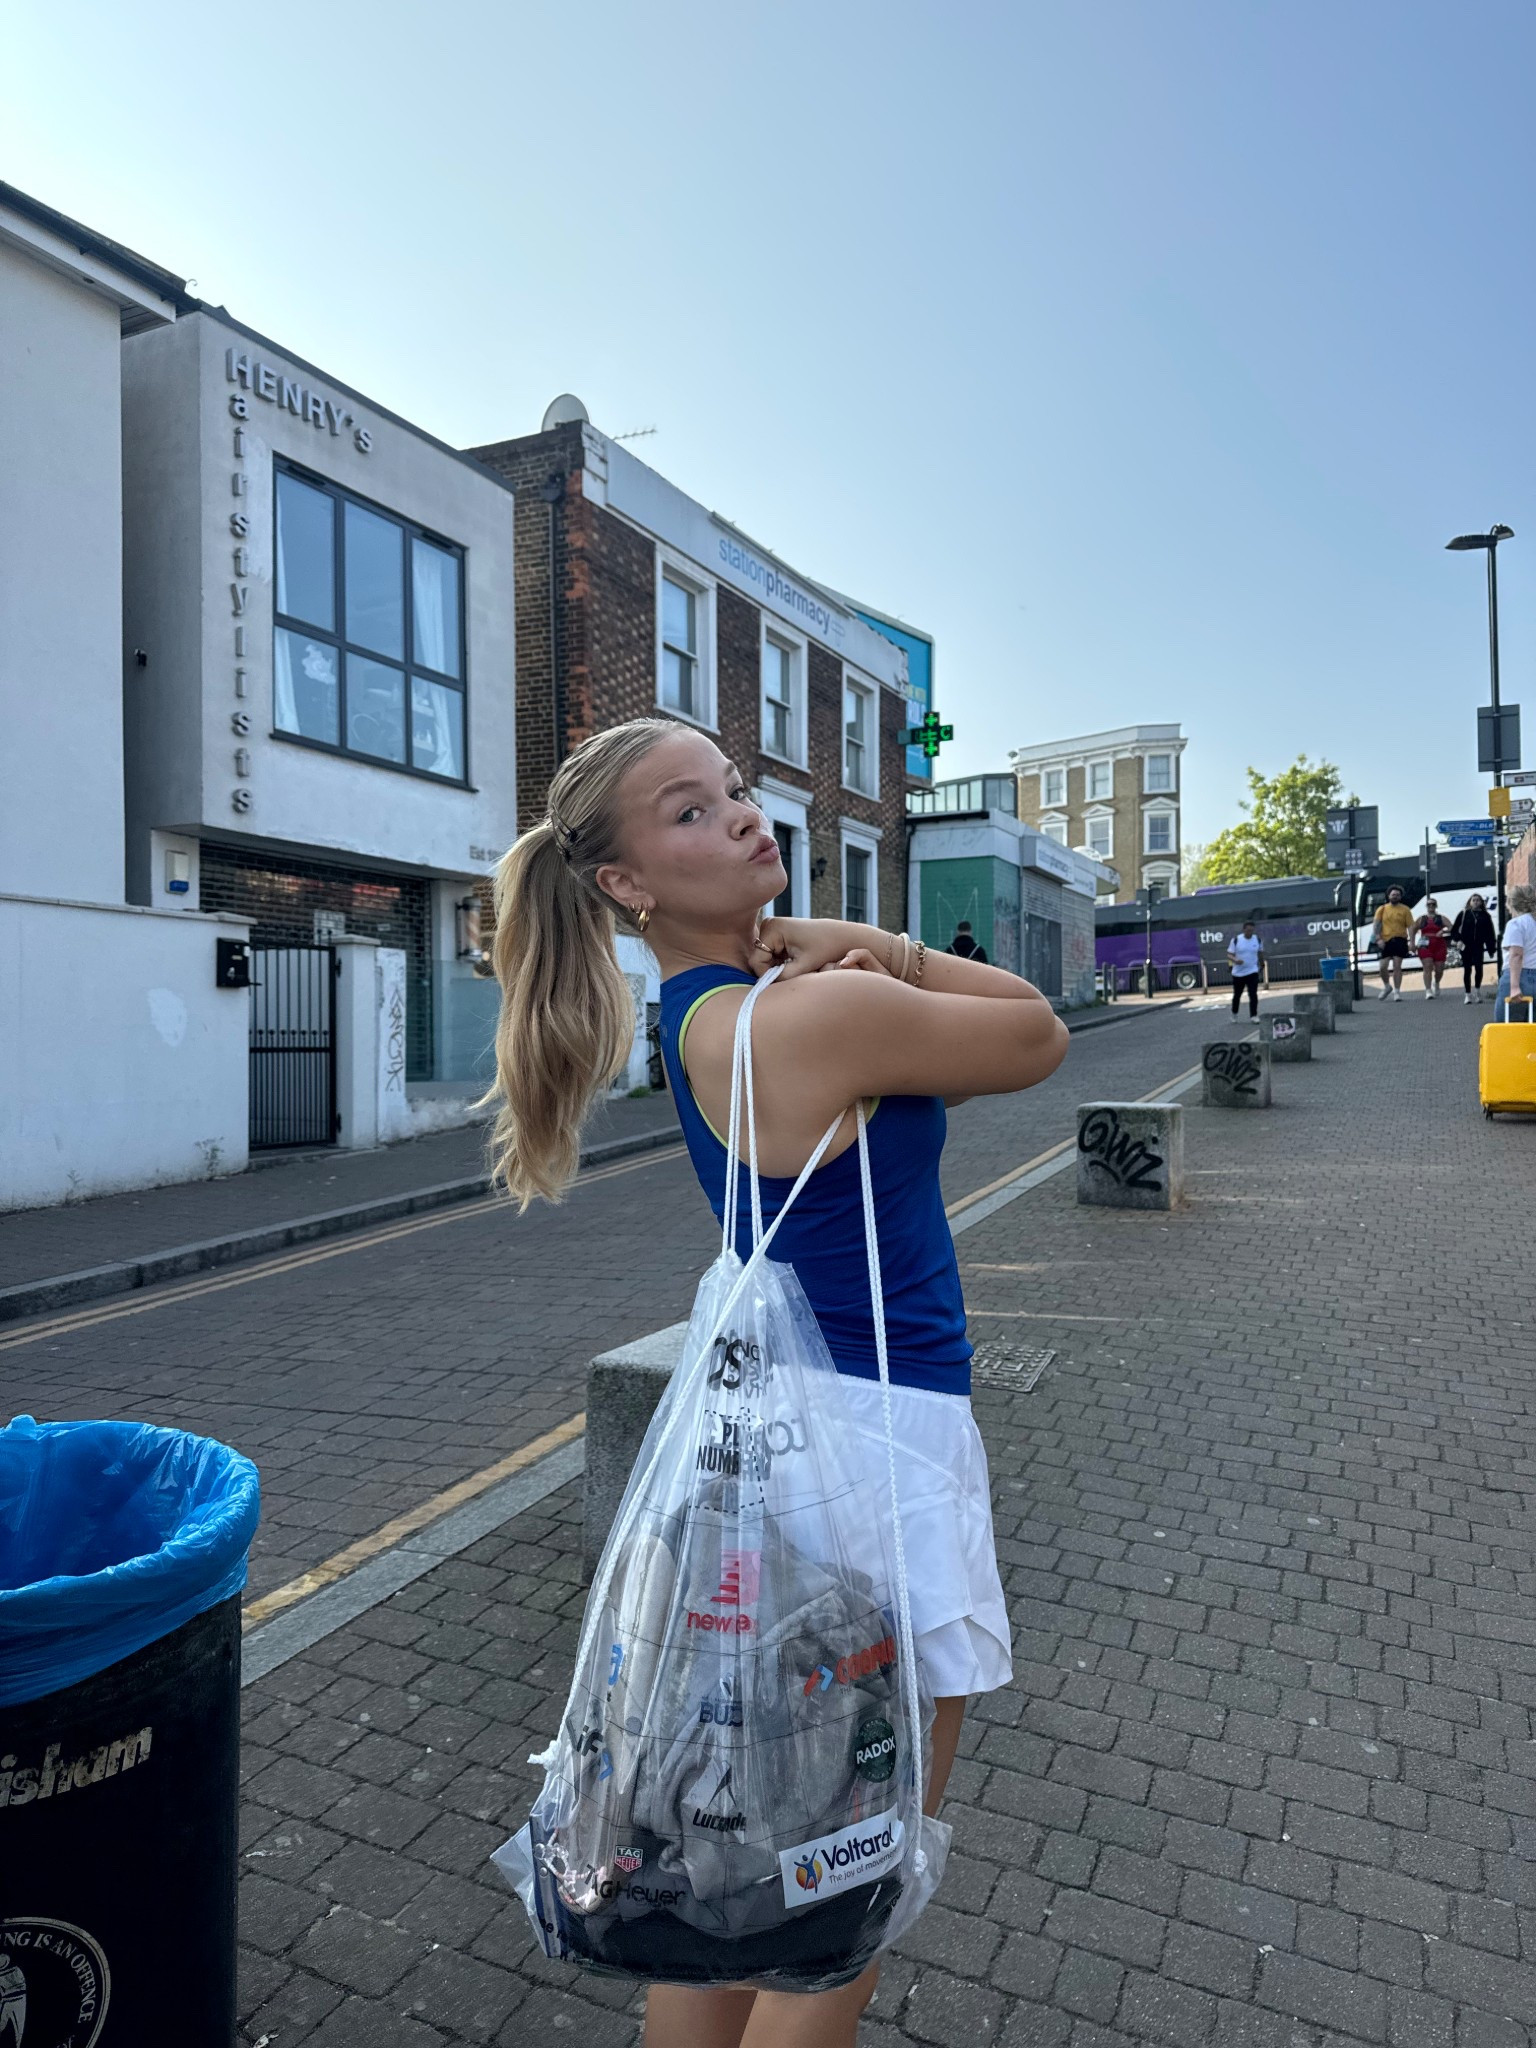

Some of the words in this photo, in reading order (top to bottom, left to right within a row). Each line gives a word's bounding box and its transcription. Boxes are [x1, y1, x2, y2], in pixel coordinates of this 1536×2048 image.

[226, 347, 373, 454] HENRY'S
[1200, 930, 1224, 944] the
[1307, 919, 1351, 936] group
[856, 1735, 896, 1765] RADOX
[618, 1847, 641, 1858] TAG
[821, 1822, 895, 1871] Voltarol
[829, 1872, 843, 1884] The
[844, 1869, 855, 1880] joy
[857, 1864, 865, 1874] of
[33, 1933, 53, 1949] IS
[49, 1939, 77, 1959] AN
[70, 1953, 96, 2024] OFFENCE
